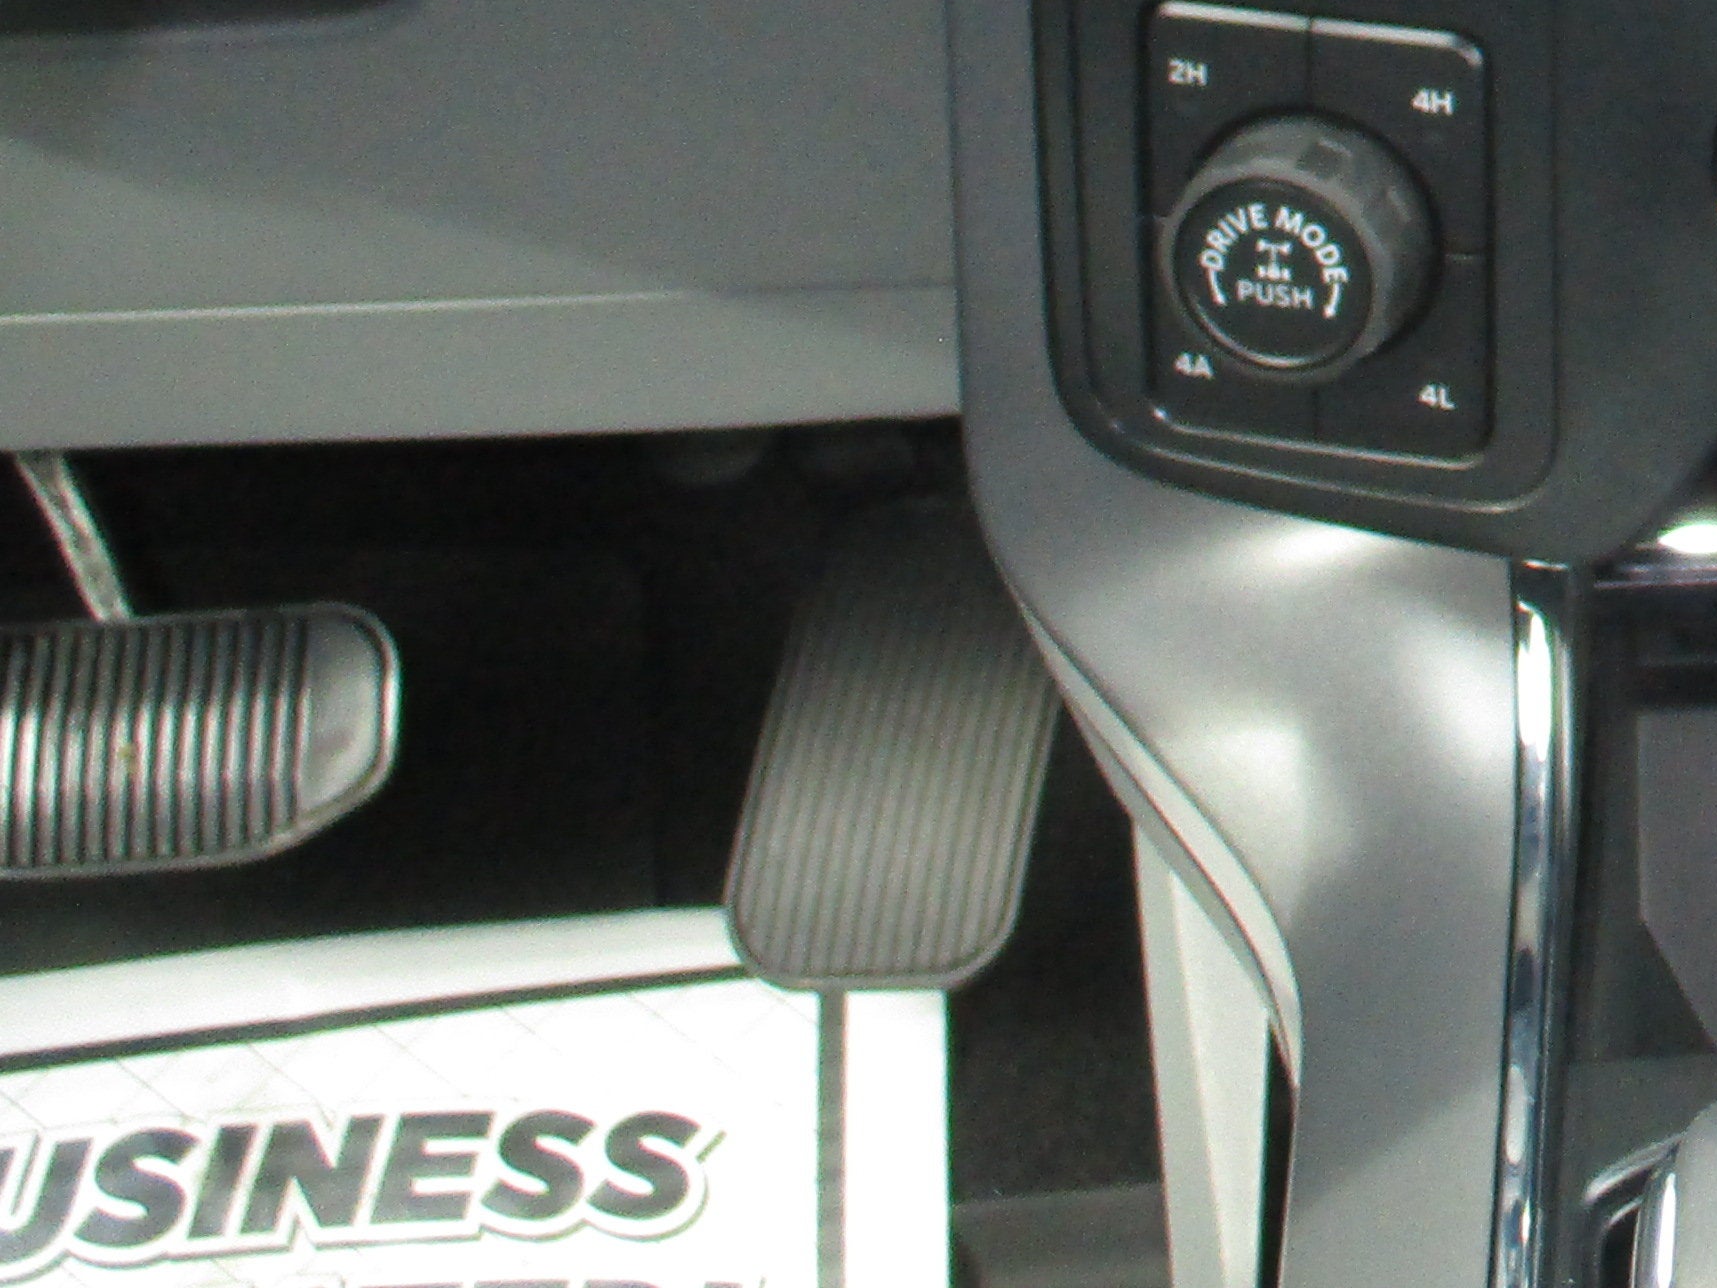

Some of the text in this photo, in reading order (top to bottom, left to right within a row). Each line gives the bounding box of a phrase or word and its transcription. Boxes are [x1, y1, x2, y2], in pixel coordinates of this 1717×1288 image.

[1168, 57, 1209, 87] 2H
[1411, 88, 1456, 116] 4H
[1200, 202, 1350, 285] DRIVE MODE
[1236, 280, 1314, 311] PUSH
[1173, 352, 1215, 381] 4A
[1418, 383, 1457, 412] 4L
